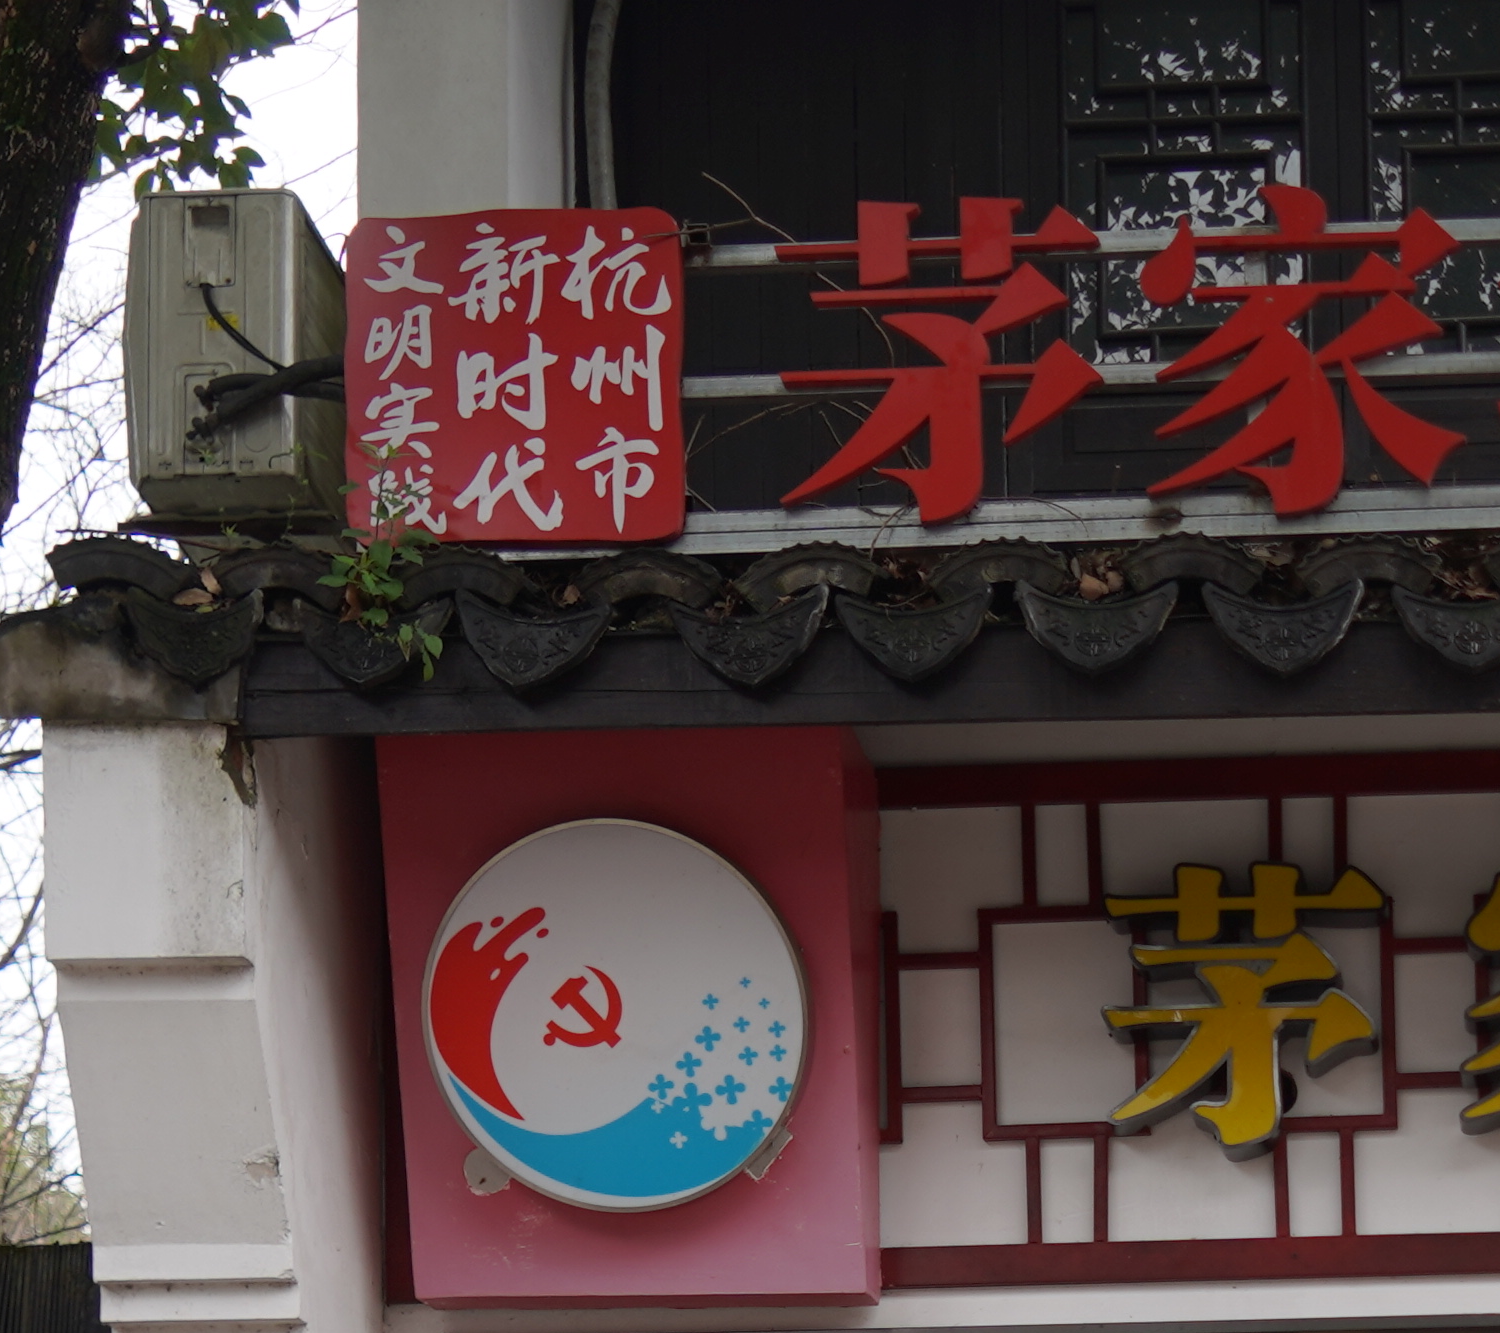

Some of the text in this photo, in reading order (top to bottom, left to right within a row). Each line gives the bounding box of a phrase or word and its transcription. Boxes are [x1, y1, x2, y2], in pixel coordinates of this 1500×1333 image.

[360, 226, 447, 535] 文明实践
[448, 222, 564, 532] 新时代
[561, 225, 672, 534] 杭州市
